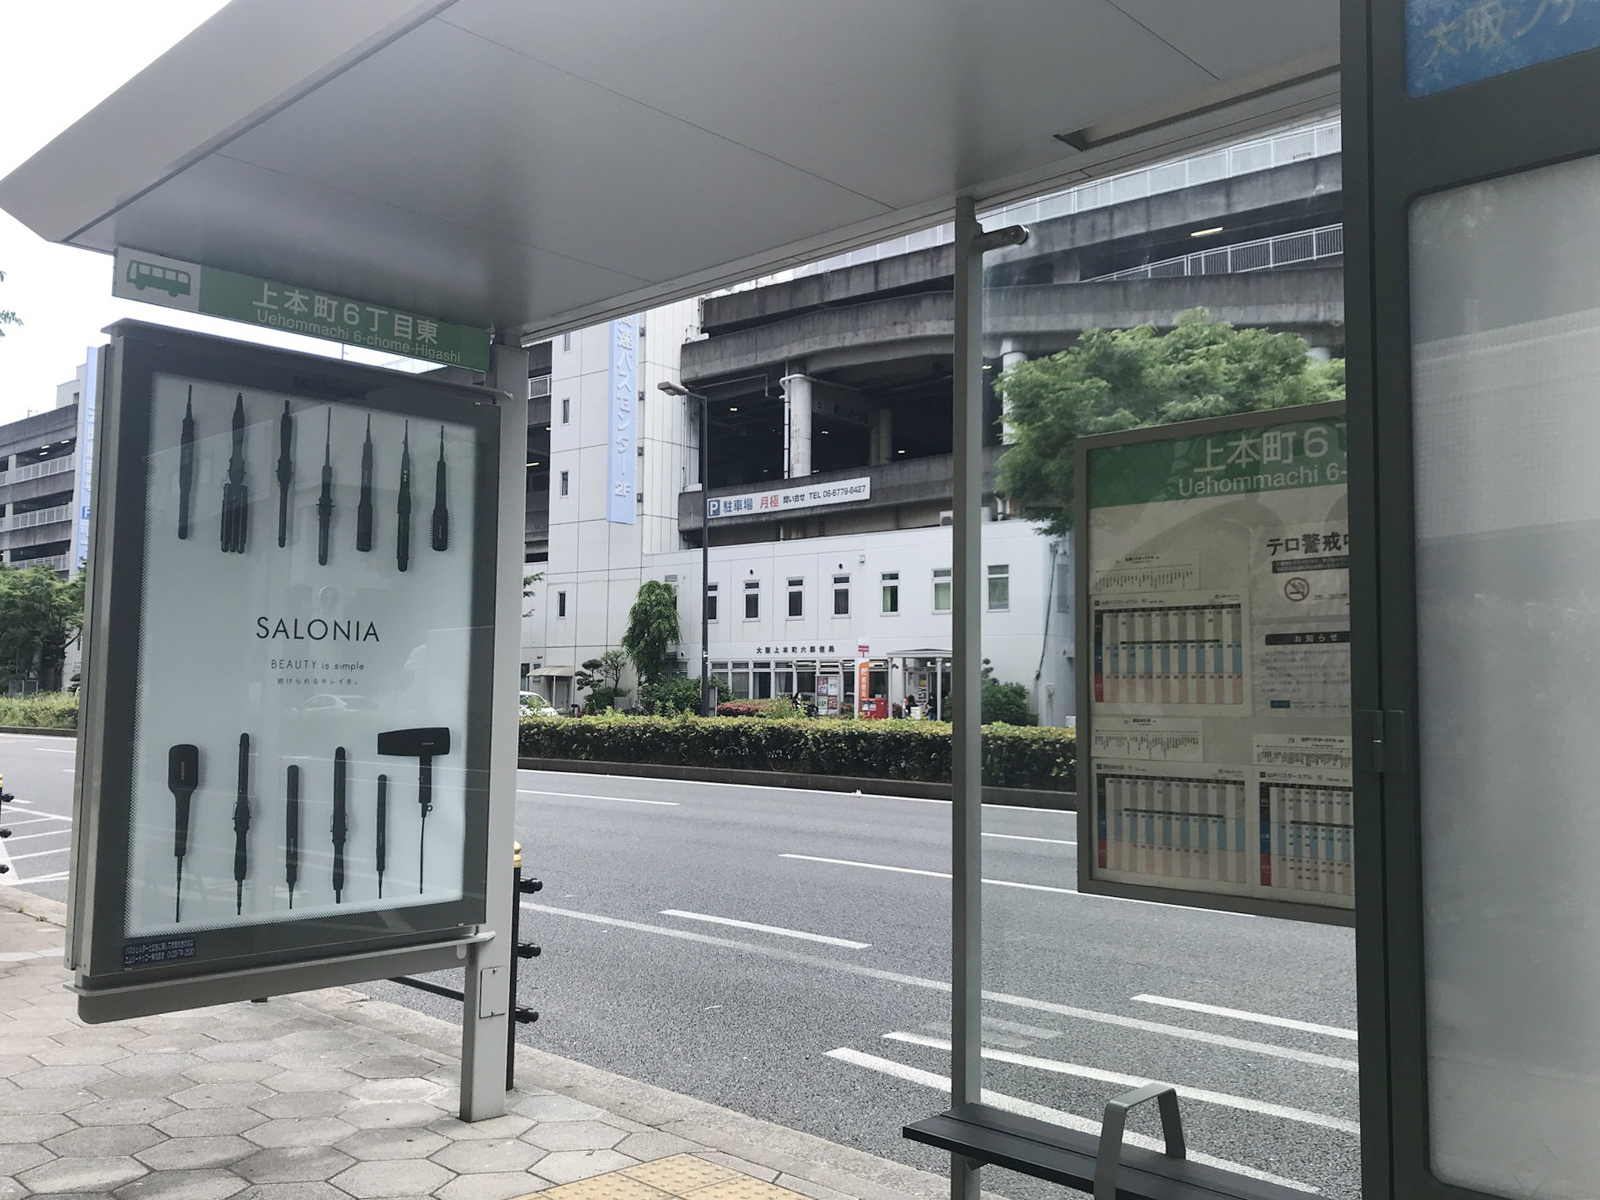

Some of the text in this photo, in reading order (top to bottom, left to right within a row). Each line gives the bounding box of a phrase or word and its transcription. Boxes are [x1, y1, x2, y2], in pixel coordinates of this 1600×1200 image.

[252, 282, 439, 345] 上本町6丁目東
[257, 309, 461, 364] Uehommachi 6-chome-Higashi
[1179, 465, 1318, 497] Uehommachi
[723, 497, 753, 513] 駐車場
[760, 494, 779, 509] 月極
[809, 491, 821, 500] TEL
[256, 616, 380, 642] SALONIA
[1294, 634, 1338, 643] お知らせ
[756, 645, 835, 655] 大阪上本町六郵便局
[270, 659, 365, 672] BEAUTY is simple
